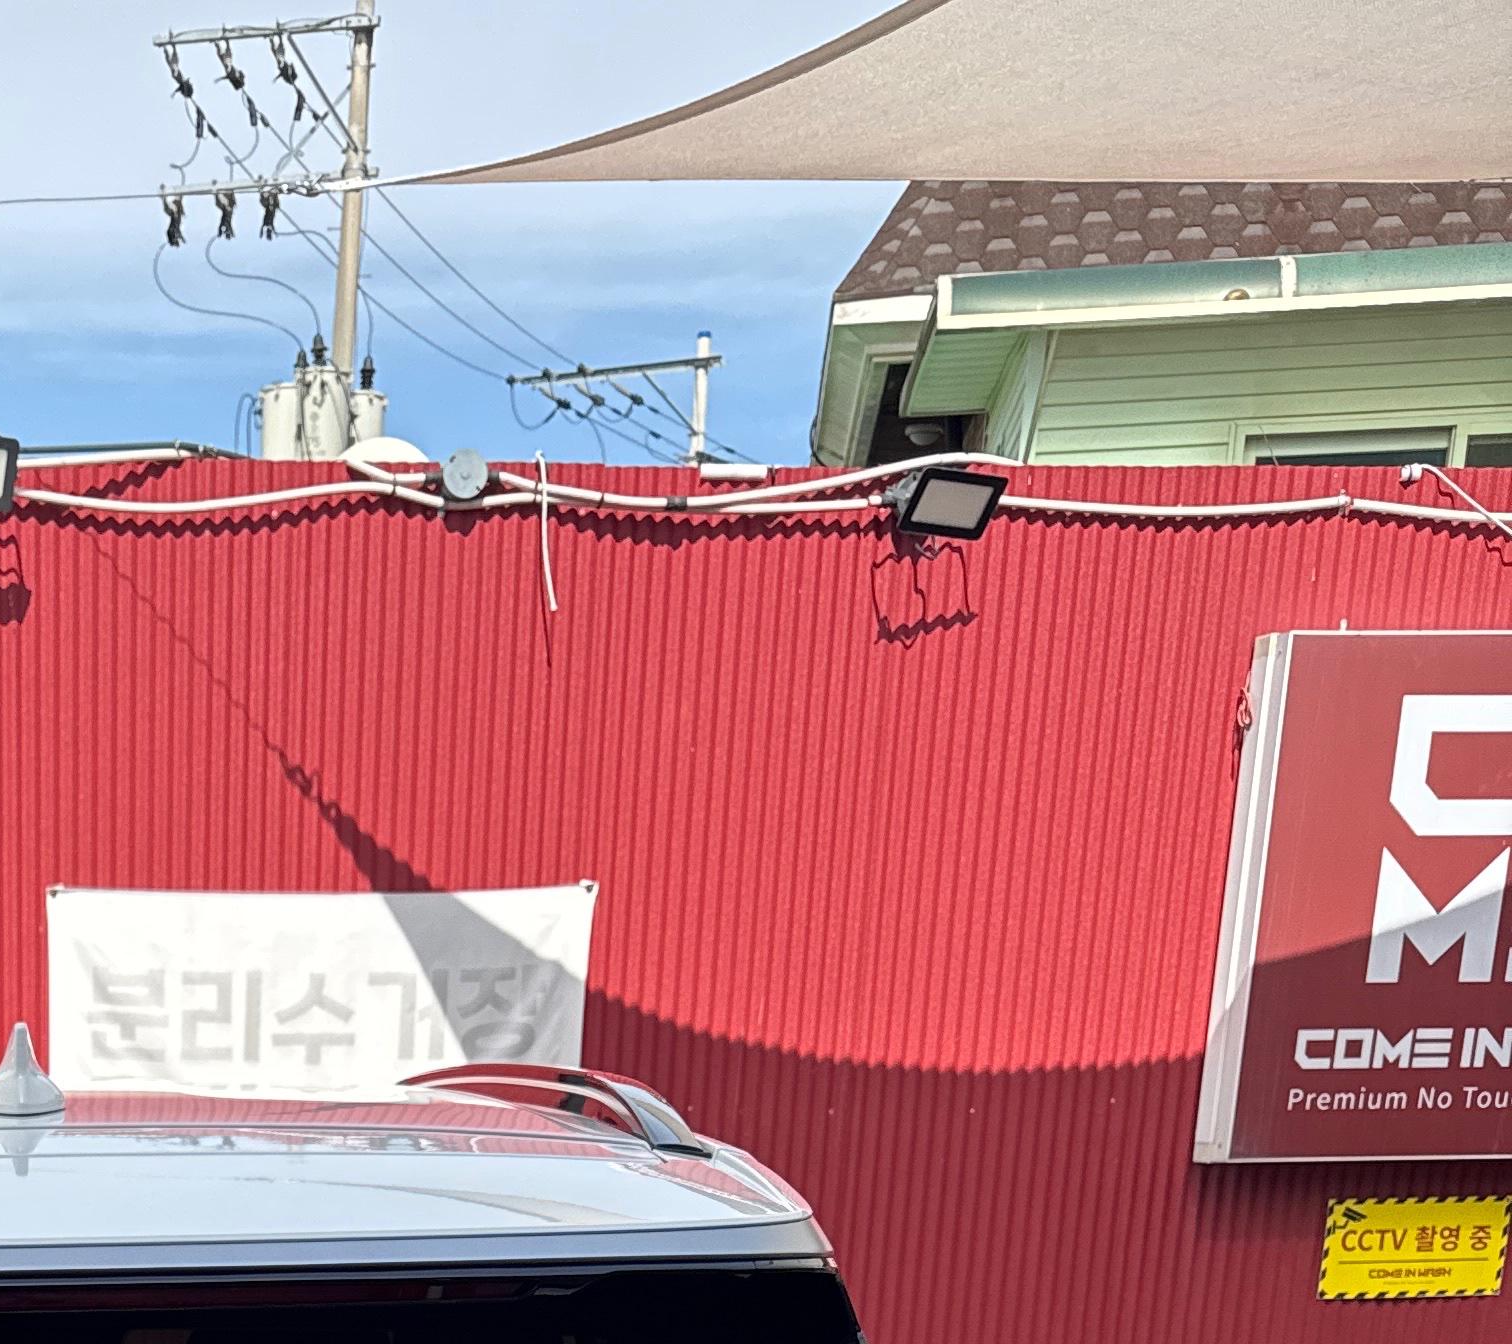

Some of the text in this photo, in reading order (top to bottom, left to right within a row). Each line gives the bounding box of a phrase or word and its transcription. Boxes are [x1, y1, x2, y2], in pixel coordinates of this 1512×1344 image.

[1365, 846, 1512, 984] M
[85, 965, 538, 1065] 분리수거장
[1294, 1027, 1454, 1070] COME
[1287, 1086, 1512, 1111] Premium No Tou
[1341, 1224, 1492, 1253] CCTV 촬영 중
